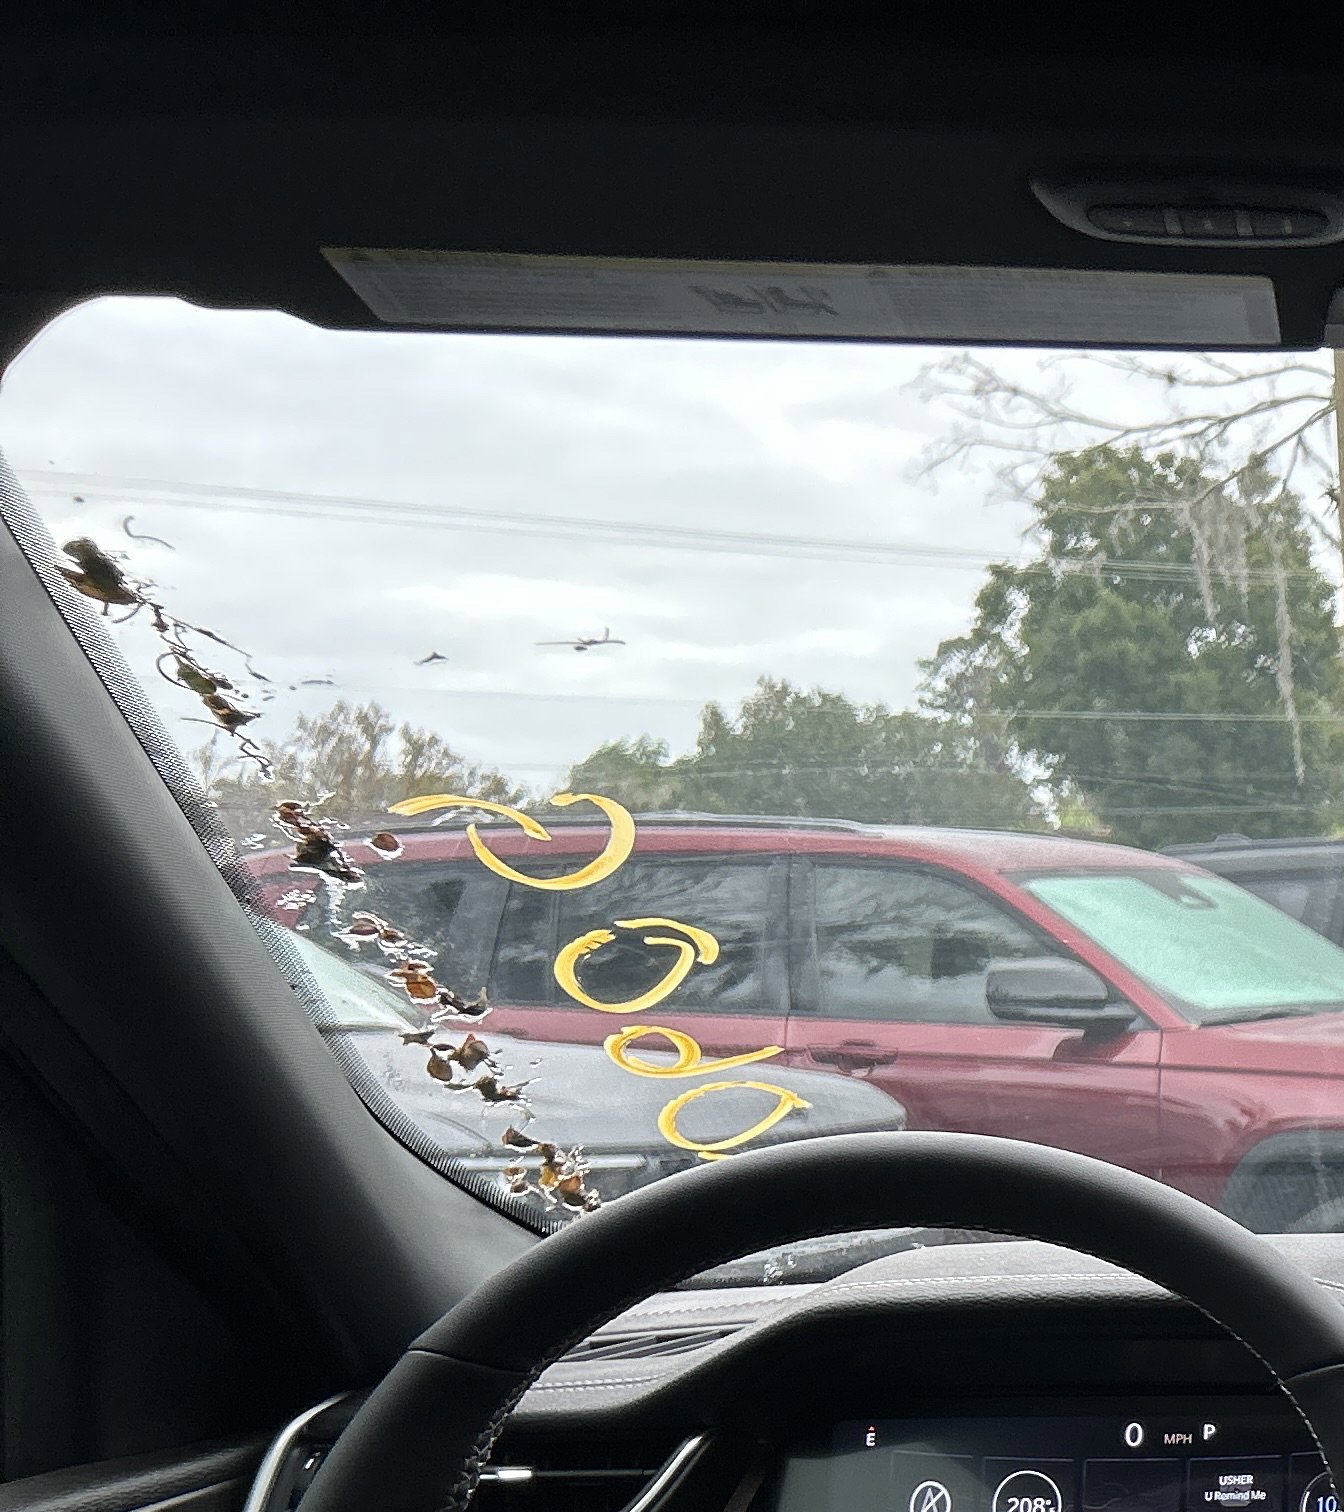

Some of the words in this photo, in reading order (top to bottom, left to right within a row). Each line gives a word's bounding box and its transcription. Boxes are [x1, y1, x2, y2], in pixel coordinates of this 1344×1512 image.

[1125, 1422, 1143, 1447] 0
[1164, 1433, 1192, 1444] MPH
[1203, 1423, 1216, 1439] P
[866, 1432, 876, 1446] E
[1219, 1475, 1254, 1486] USHER
[1204, 1492, 1213, 1501] U
[1214, 1491, 1250, 1501] Remind
[1251, 1490, 1267, 1500] Me
